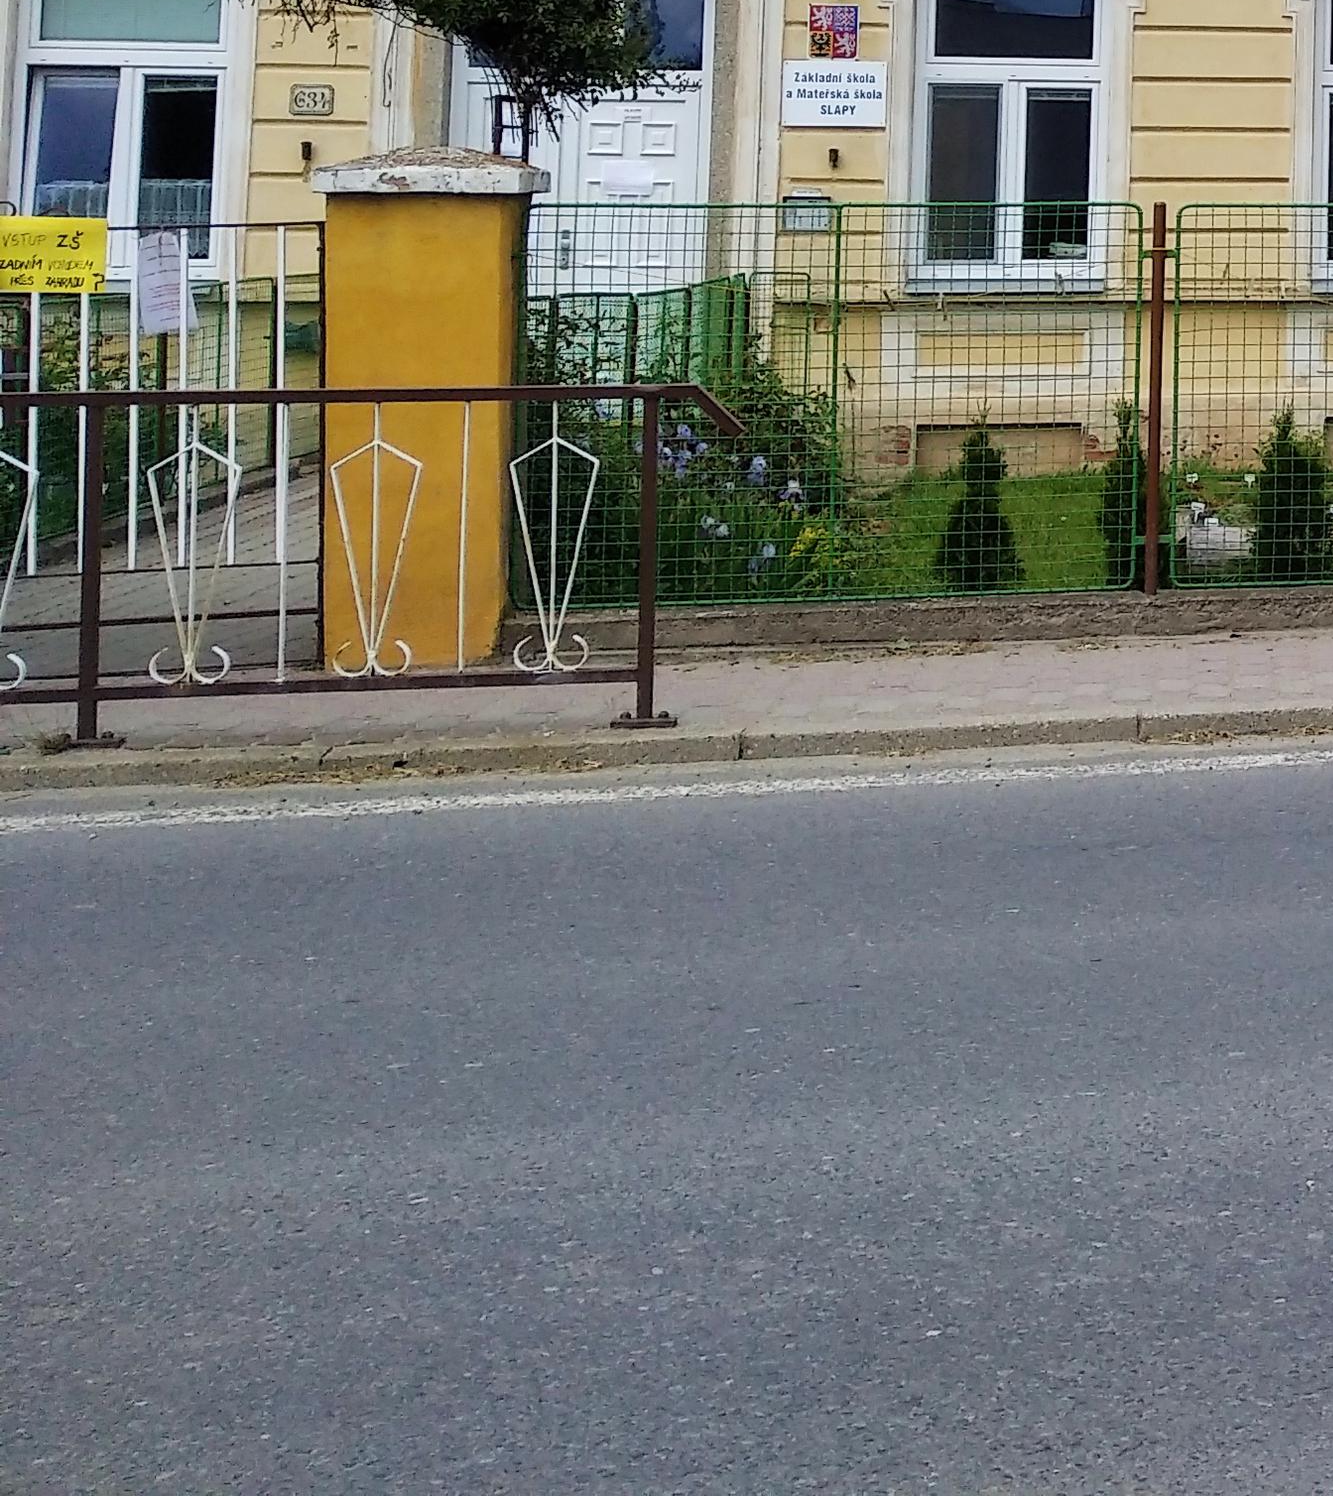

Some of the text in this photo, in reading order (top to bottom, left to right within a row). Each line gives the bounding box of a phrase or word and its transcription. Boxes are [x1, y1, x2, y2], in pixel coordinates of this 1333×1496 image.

[794, 71, 876, 83] Základní škola
[294, 90, 331, 109] 634
[786, 88, 883, 99] a Mateřská škola
[820, 105, 856, 115] SLAPY
[2, 230, 84, 250] VSTUP ZŠ
